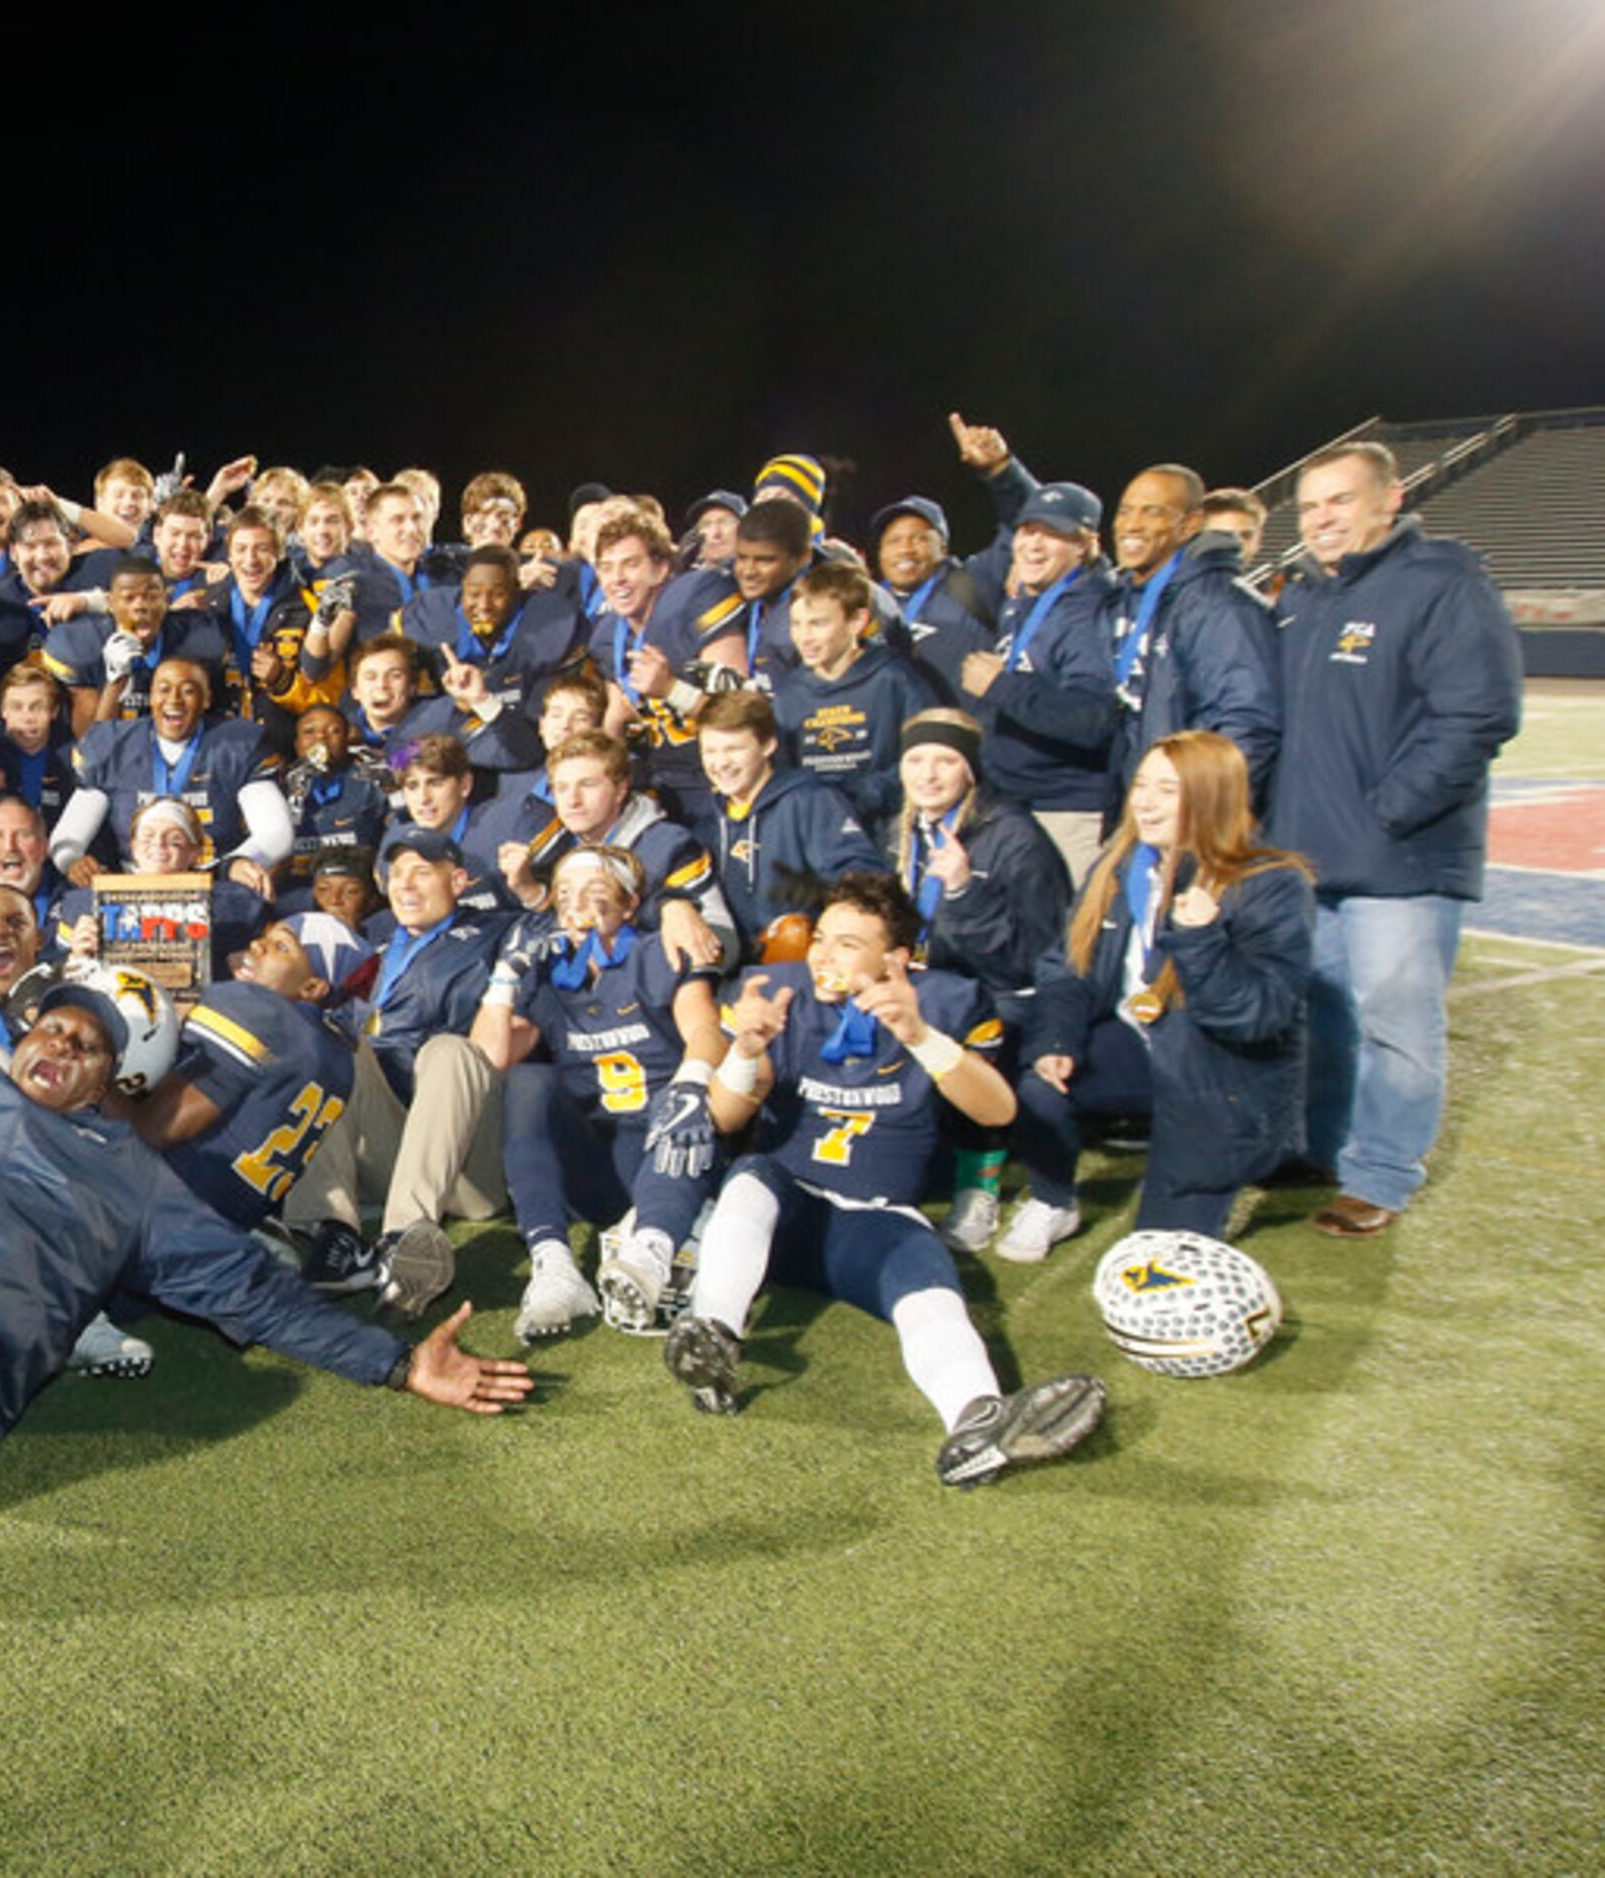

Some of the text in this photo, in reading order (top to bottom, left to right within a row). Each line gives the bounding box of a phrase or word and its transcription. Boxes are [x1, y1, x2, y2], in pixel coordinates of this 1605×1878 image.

[99, 902, 209, 942] TAPPS
[592, 1049, 650, 1113] 9
[810, 1106, 878, 1167] 7
